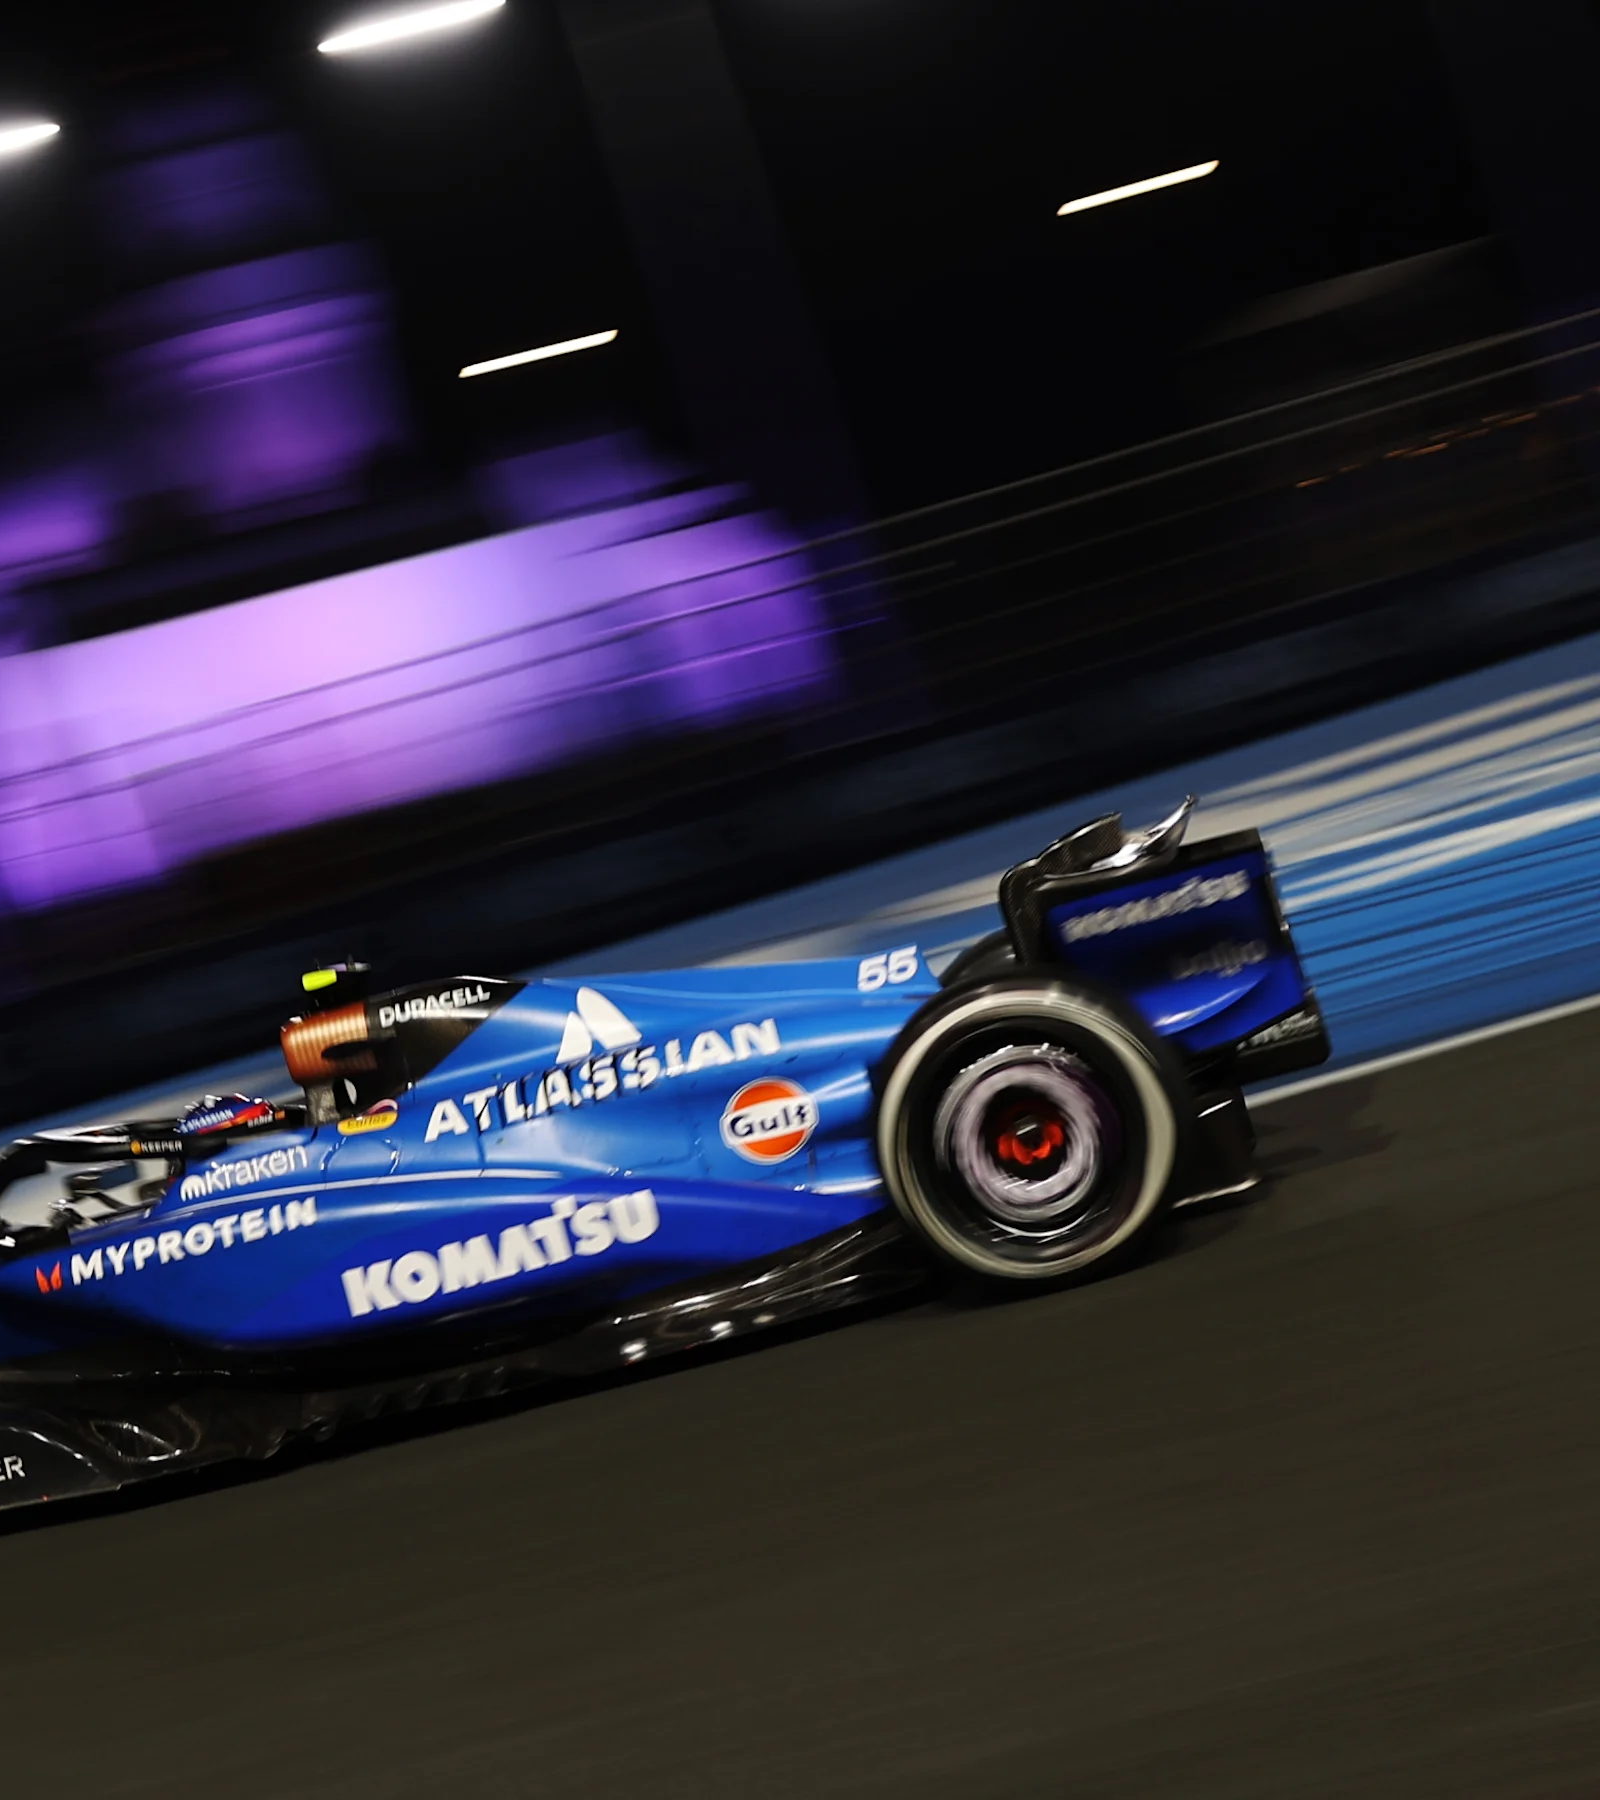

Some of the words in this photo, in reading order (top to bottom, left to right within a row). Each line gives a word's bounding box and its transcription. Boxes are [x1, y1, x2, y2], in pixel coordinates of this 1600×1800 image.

[857, 945, 918, 992] 55
[378, 983, 491, 1029] DURACELL
[423, 1017, 782, 1143] ATLASSIAN
[729, 1104, 807, 1137] Gulf
[140, 1140, 183, 1153] KEEPER
[70, 1196, 318, 1286] MYPROTEIN
[341, 1188, 660, 1317] KOMATSU
